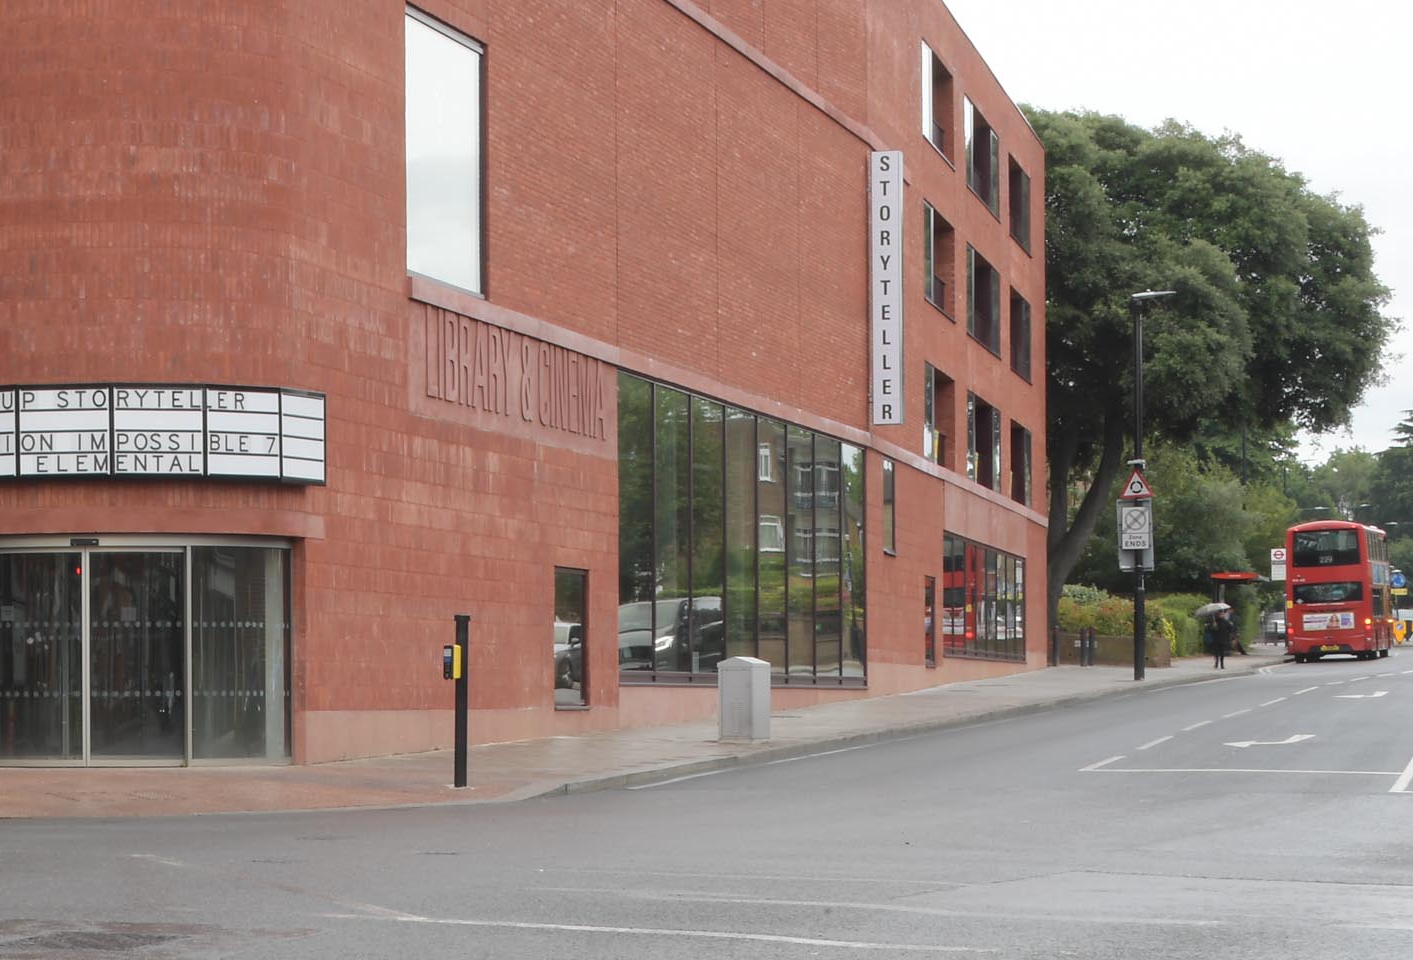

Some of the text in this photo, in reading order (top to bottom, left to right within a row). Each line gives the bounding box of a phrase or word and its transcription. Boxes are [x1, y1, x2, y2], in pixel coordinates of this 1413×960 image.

[879, 155, 892, 420] STORYTELLER
[425, 304, 607, 441] LIBRARY & CINEMA
[56, 390, 247, 410] STORYTELLER
[77, 432, 250, 453] IMPOSSIBLE
[266, 436, 278, 454] 7
[36, 455, 201, 473] ELEMENTAL
